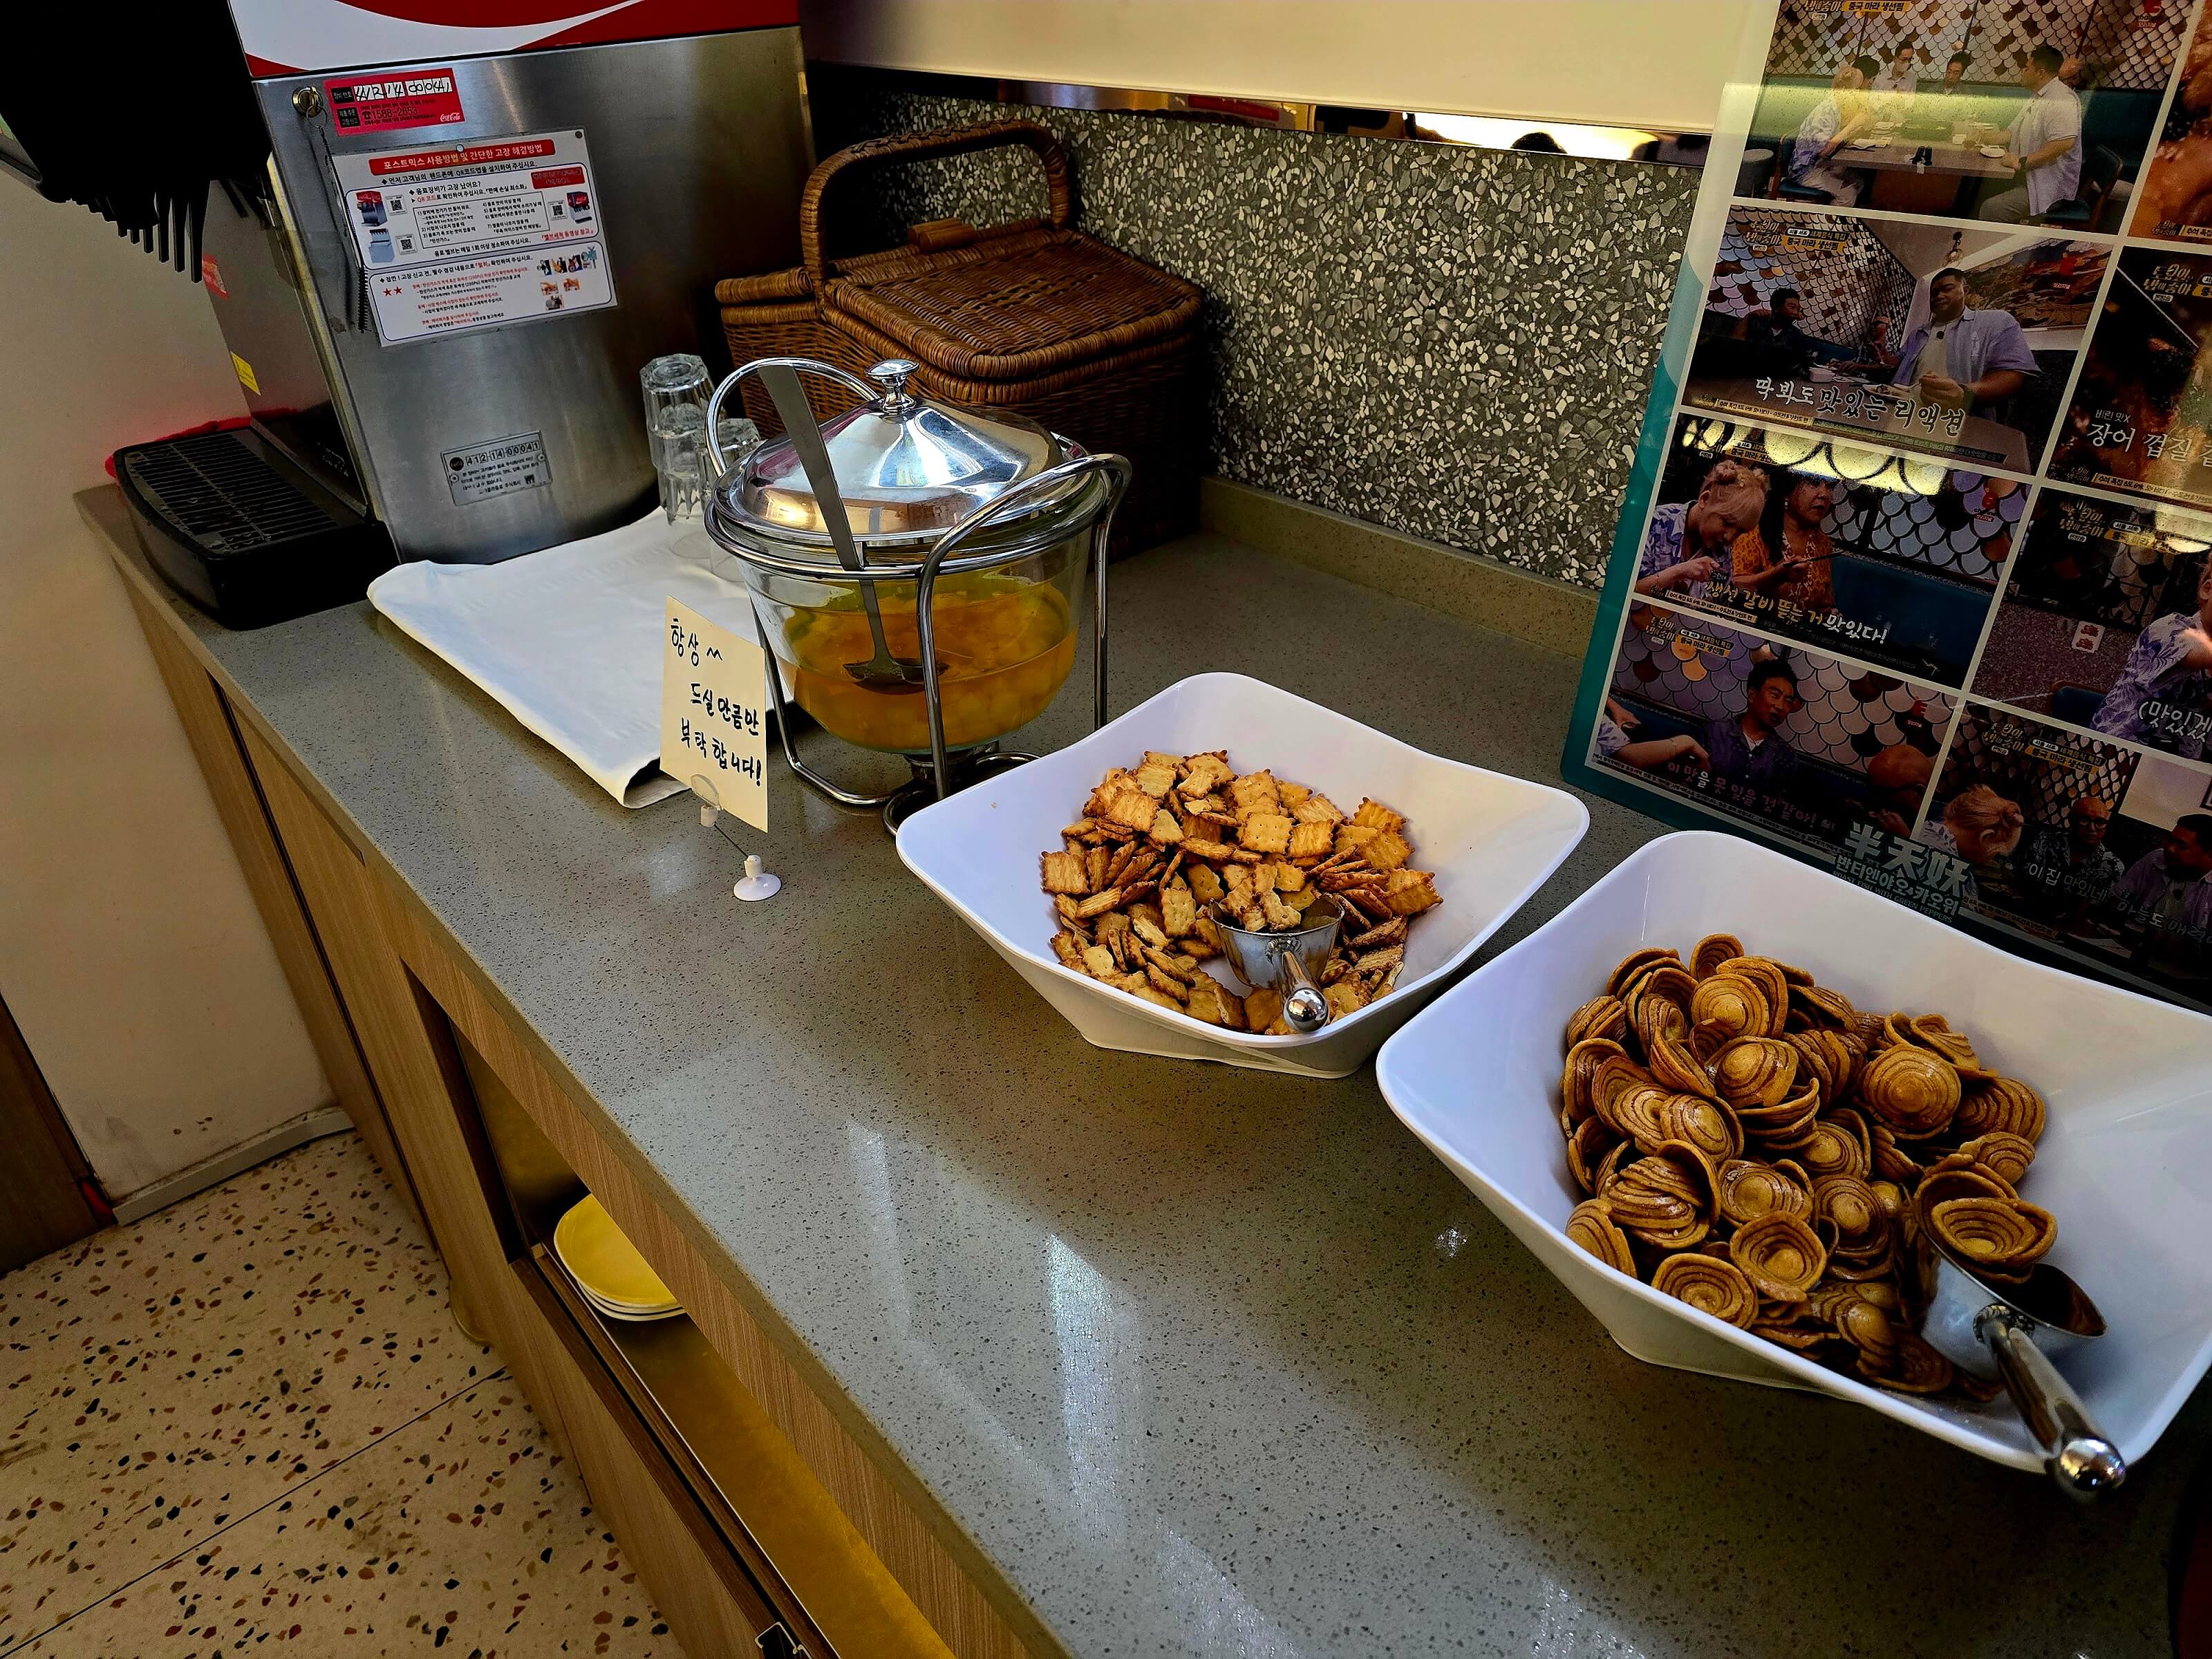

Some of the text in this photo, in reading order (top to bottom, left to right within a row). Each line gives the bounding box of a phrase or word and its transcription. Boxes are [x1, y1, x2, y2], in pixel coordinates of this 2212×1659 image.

[1866, 1, 1880, 11] 마라
[384, 143, 543, 169] 포스트믹스 사용방법 및 간단한 고장 해결방법
[1786, 237, 1801, 246] 중국
[1802, 238, 1816, 247] 마라
[1756, 376, 1775, 401] 딱
[1775, 379, 1815, 406] 봐도
[1817, 386, 1888, 422] 맛있는
[2095, 409, 2113, 420] 비린
[2087, 423, 2136, 453] 장어
[2143, 433, 2193, 462] 껍질
[1706, 581, 1739, 601] 생선
[1743, 589, 1774, 610] 갈비
[1808, 610, 1824, 625] 거
[1825, 613, 1887, 645] 맛있다!
[671, 617, 700, 666] 항상
[1694, 641, 1706, 650] 마라
[1666, 762, 1680, 773] 이
[1683, 765, 1711, 789] 맛을
[1833, 870, 1953, 924] ROAST FISH WITH GREEN PEPPERS
[2063, 874, 2108, 902] 맛있네
